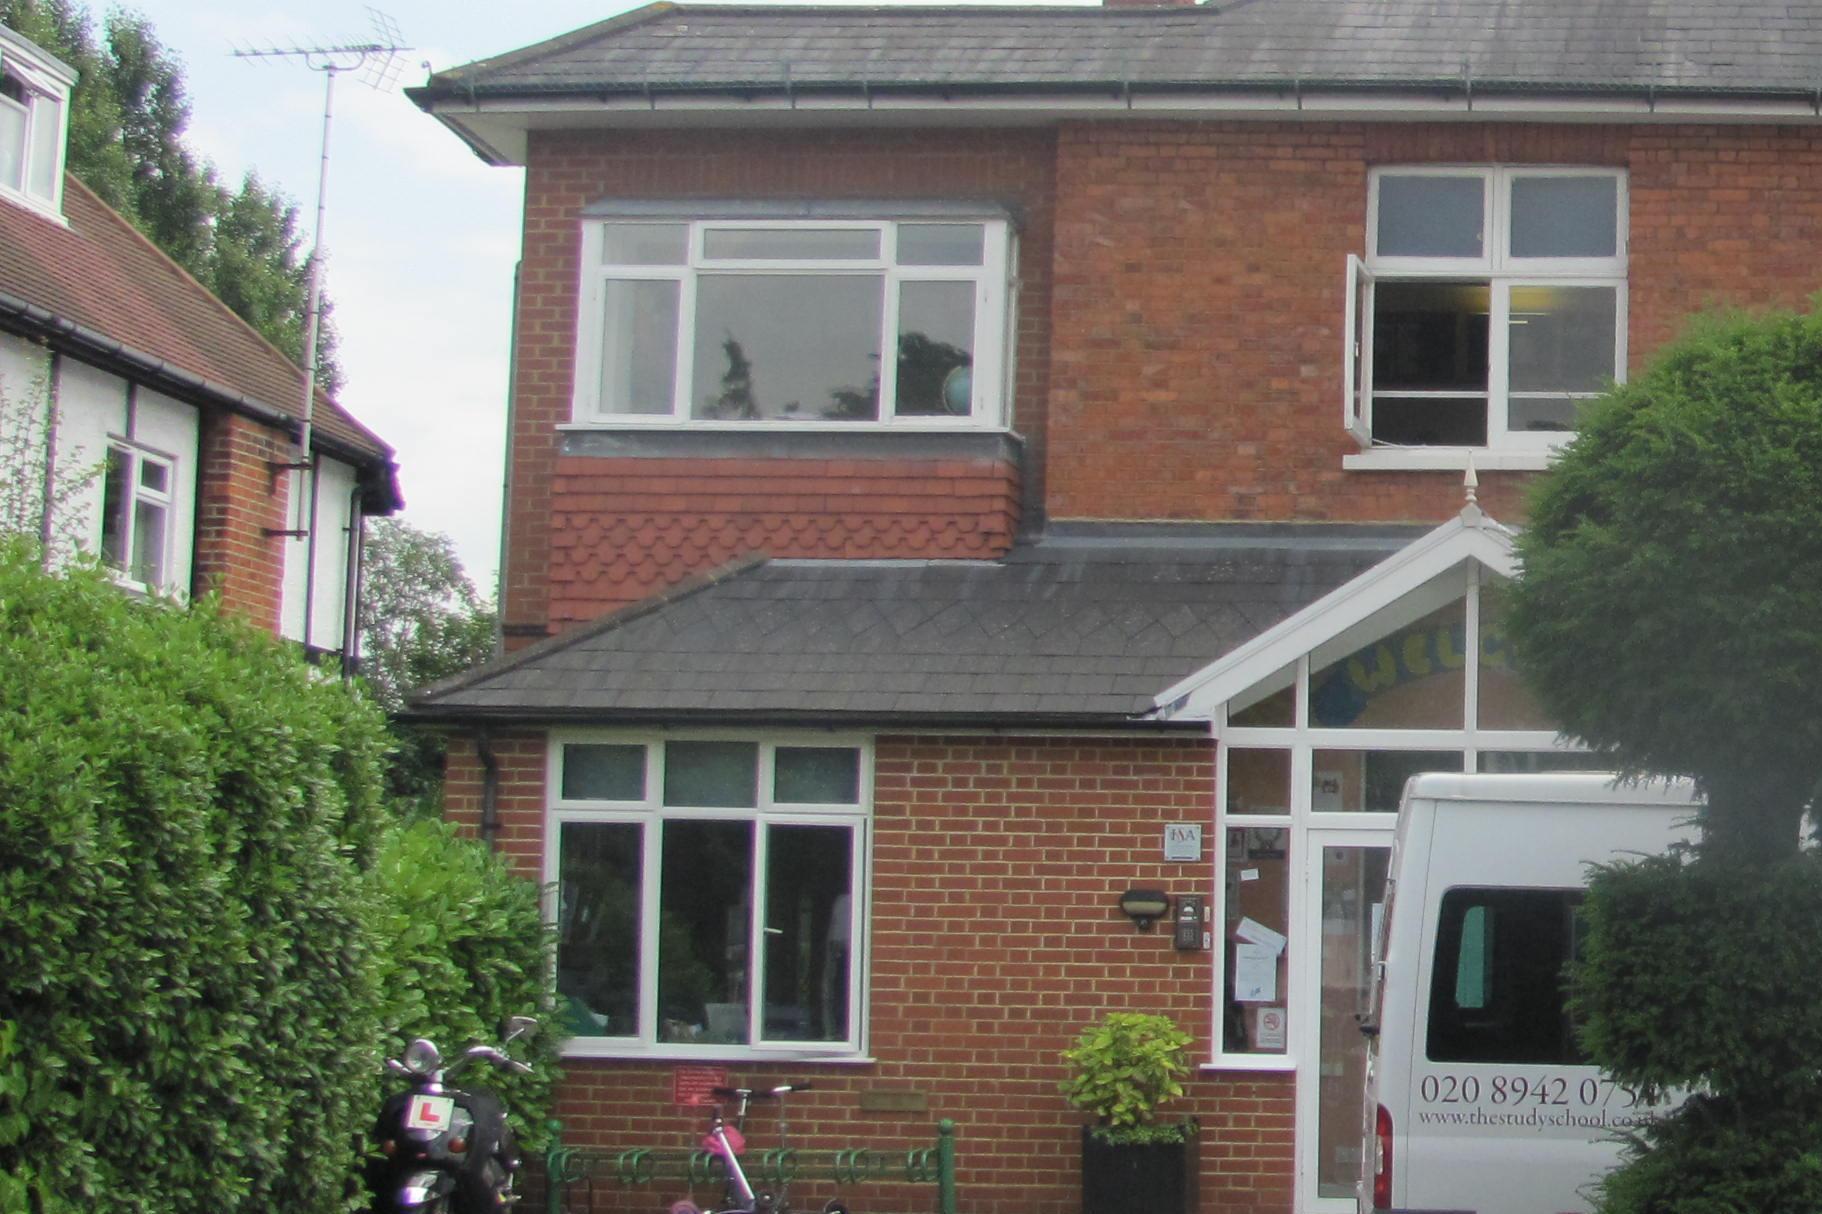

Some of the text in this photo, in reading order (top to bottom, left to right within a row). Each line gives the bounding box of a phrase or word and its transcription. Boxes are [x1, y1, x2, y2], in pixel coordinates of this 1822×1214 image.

[1420, 1074, 1480, 1104] 020
[1490, 1074, 1570, 1107] 8942
[419, 1102, 440, 1122] L
